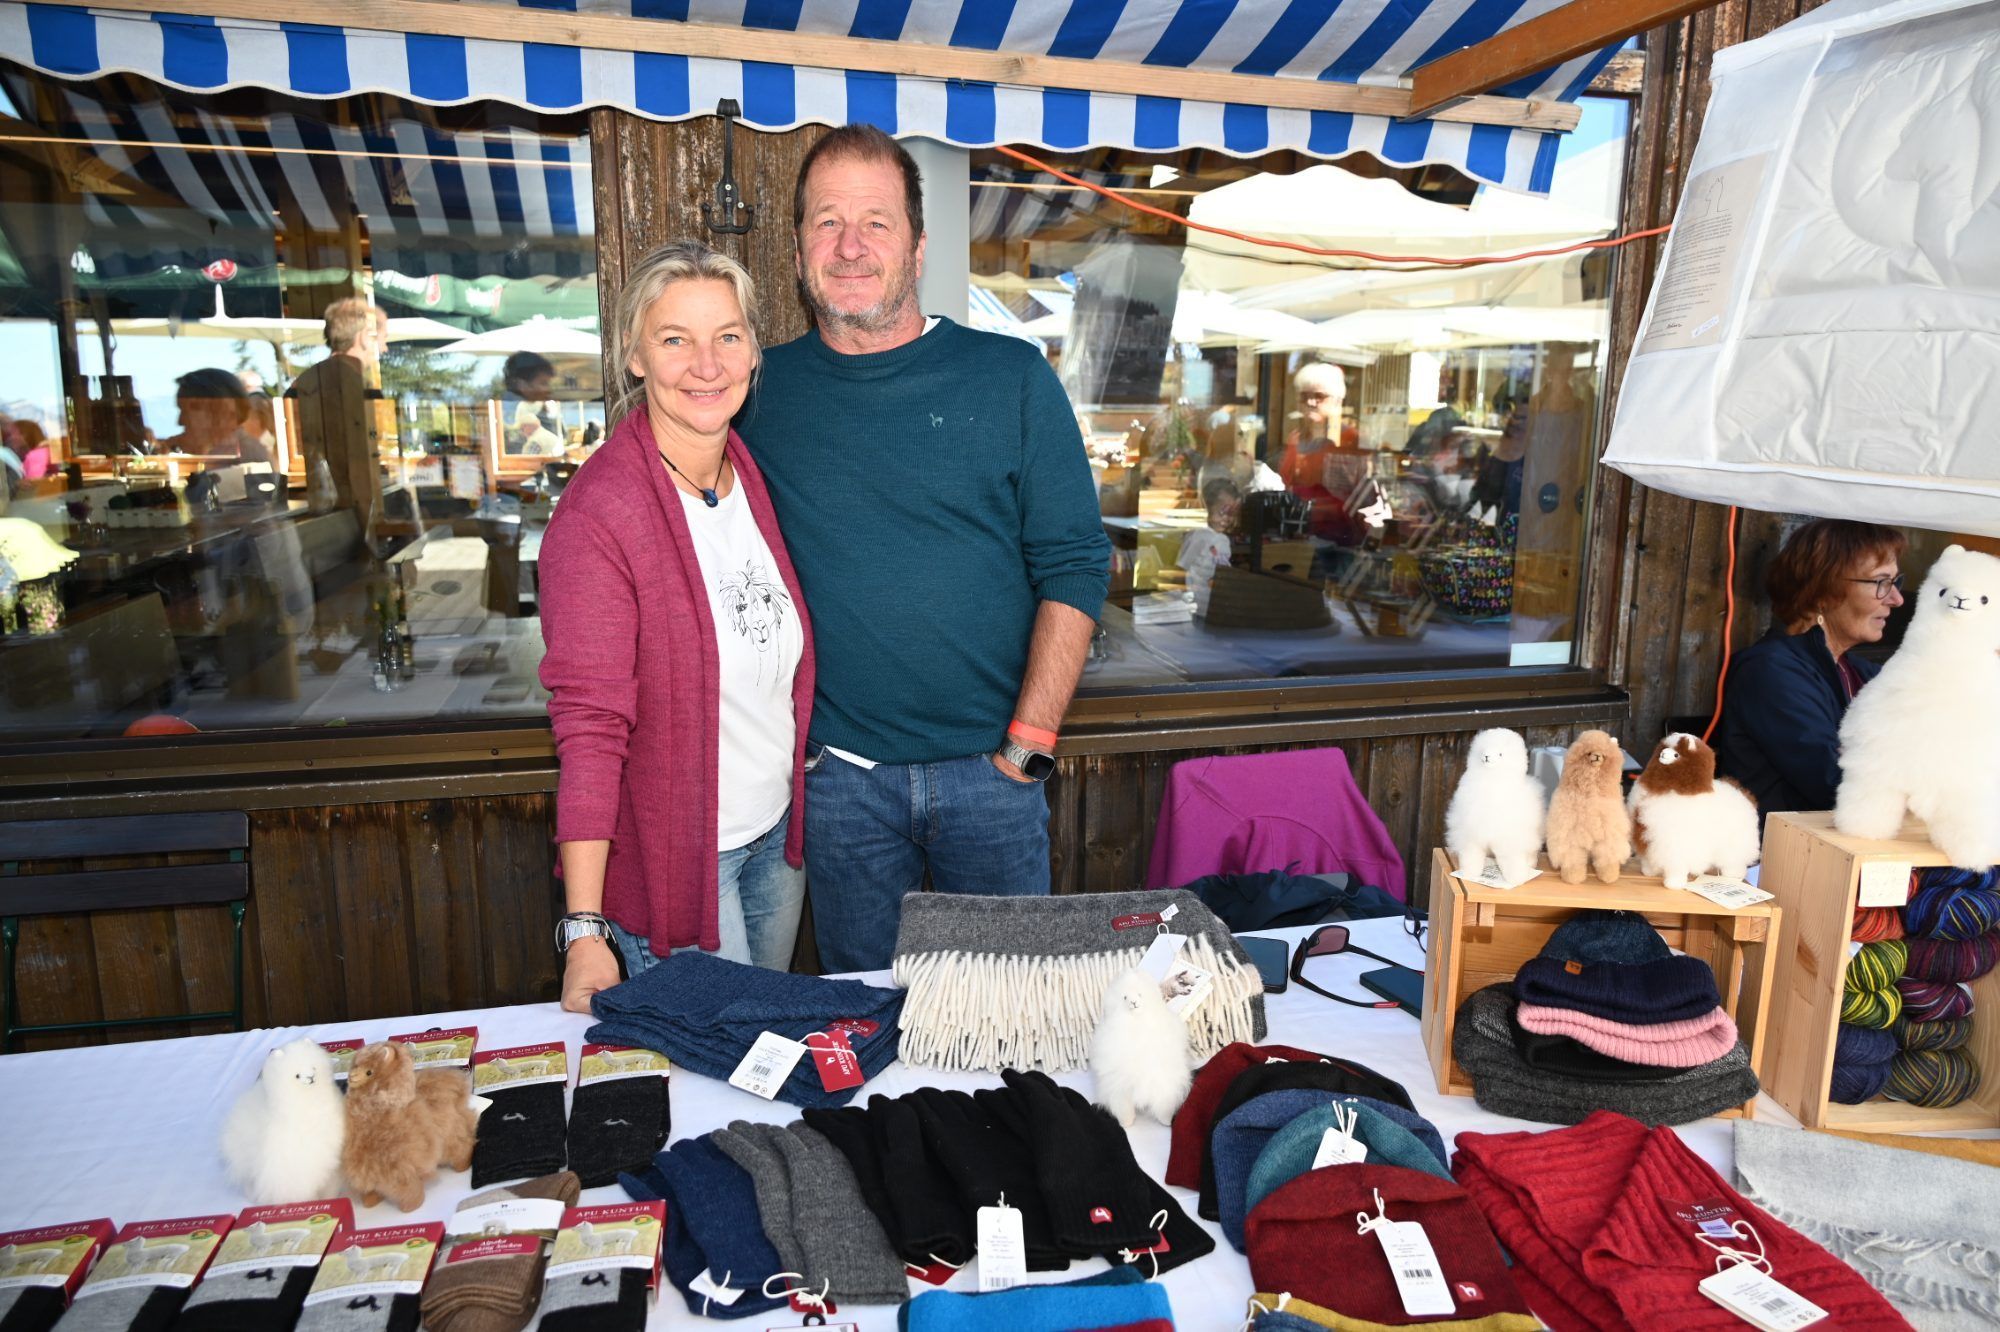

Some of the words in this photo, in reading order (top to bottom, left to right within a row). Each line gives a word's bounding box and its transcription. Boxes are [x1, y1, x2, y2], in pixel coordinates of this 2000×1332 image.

[511, 1045, 550, 1054] KUNTUR
[251, 1210, 276, 1218] APU
[279, 1204, 332, 1214] KUNTUR
[576, 1210, 599, 1218] APU
[602, 1205, 651, 1215] KUNTUR
[162, 1219, 216, 1228] KUNTUR
[346, 1233, 370, 1241] APU
[374, 1227, 427, 1238] KUNTUR
